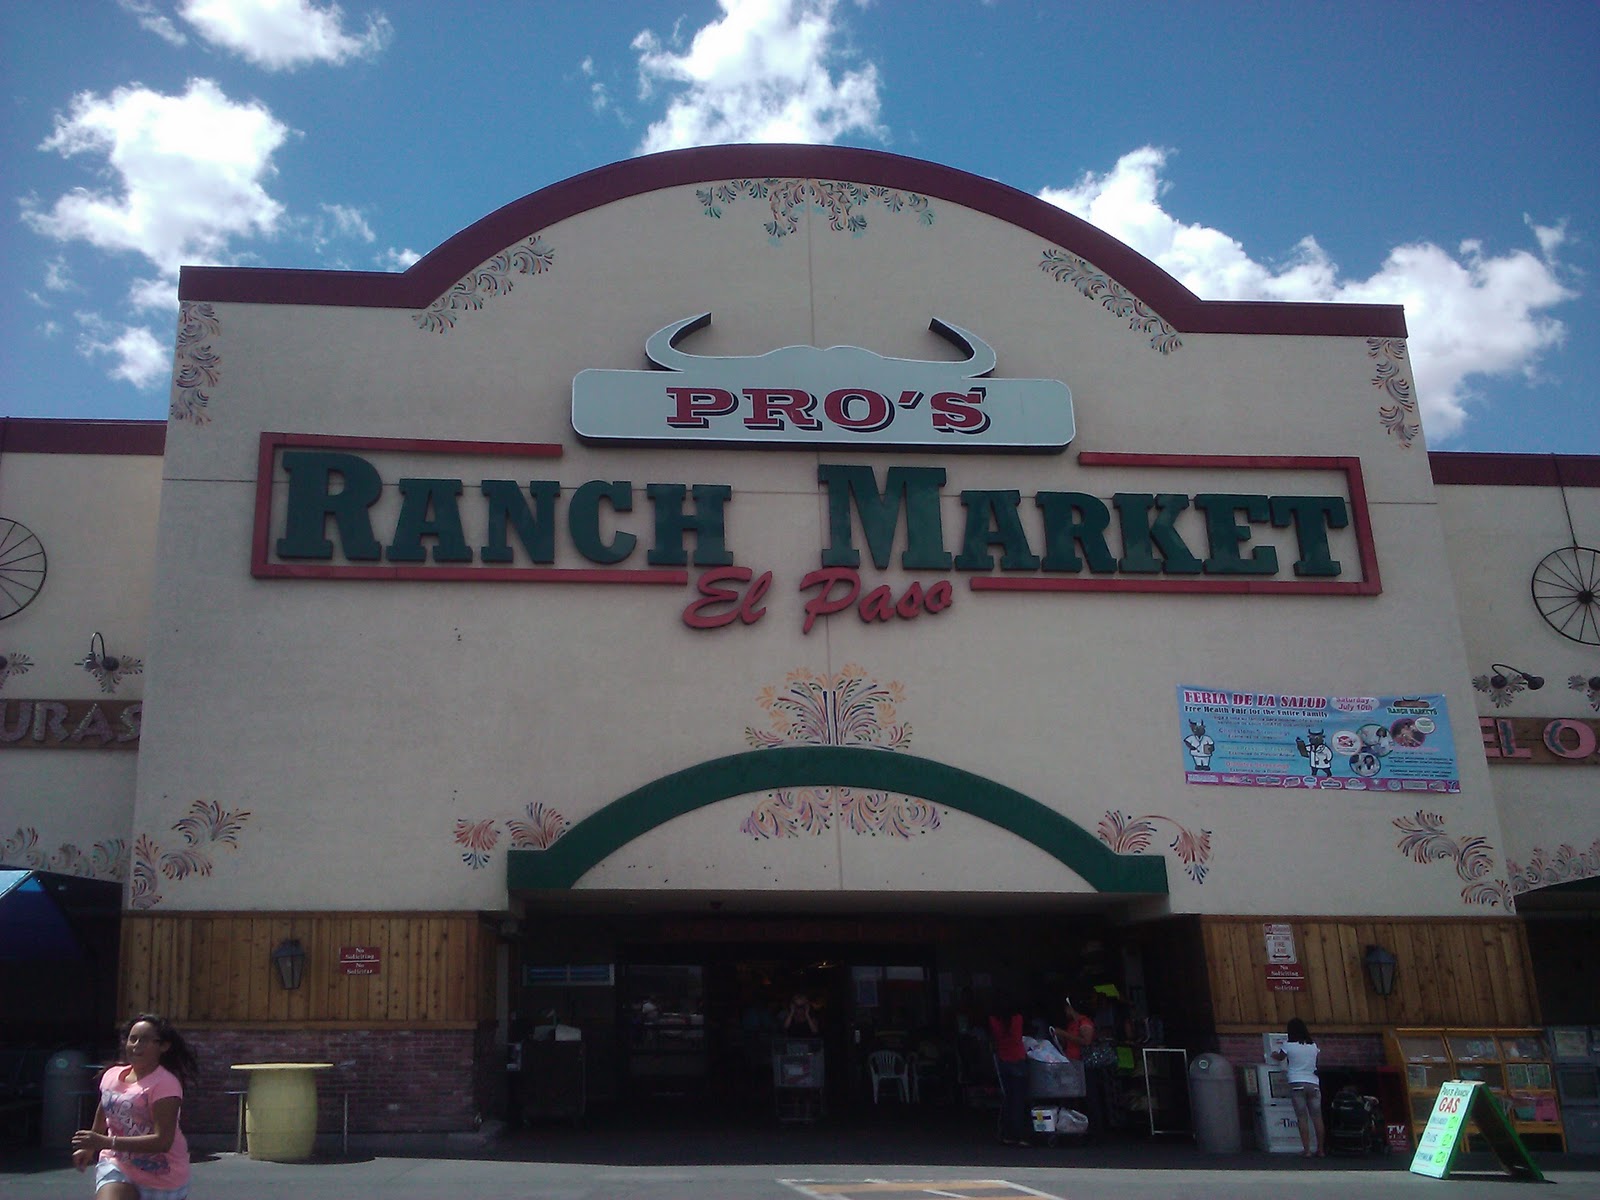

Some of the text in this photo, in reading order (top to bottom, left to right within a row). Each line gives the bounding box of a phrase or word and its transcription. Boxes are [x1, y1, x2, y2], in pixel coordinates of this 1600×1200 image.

[664, 386, 992, 435] PRO'S
[277, 451, 1349, 577] RANCH MARKET
[682, 566, 952, 635] El Paso
[1184, 691, 1327, 709] FERIA DE LA SALUD
[1204, 706, 1229, 714] Health
[1231, 707, 1247, 715] Fair
[1249, 707, 1261, 715] for
[1278, 709, 1300, 717] Entire
[1302, 710, 1329, 718] Family
[0, 700, 142, 742] URAS
[1438, 1097, 1461, 1113] GAS
[1387, 1125, 1405, 1134] TV
